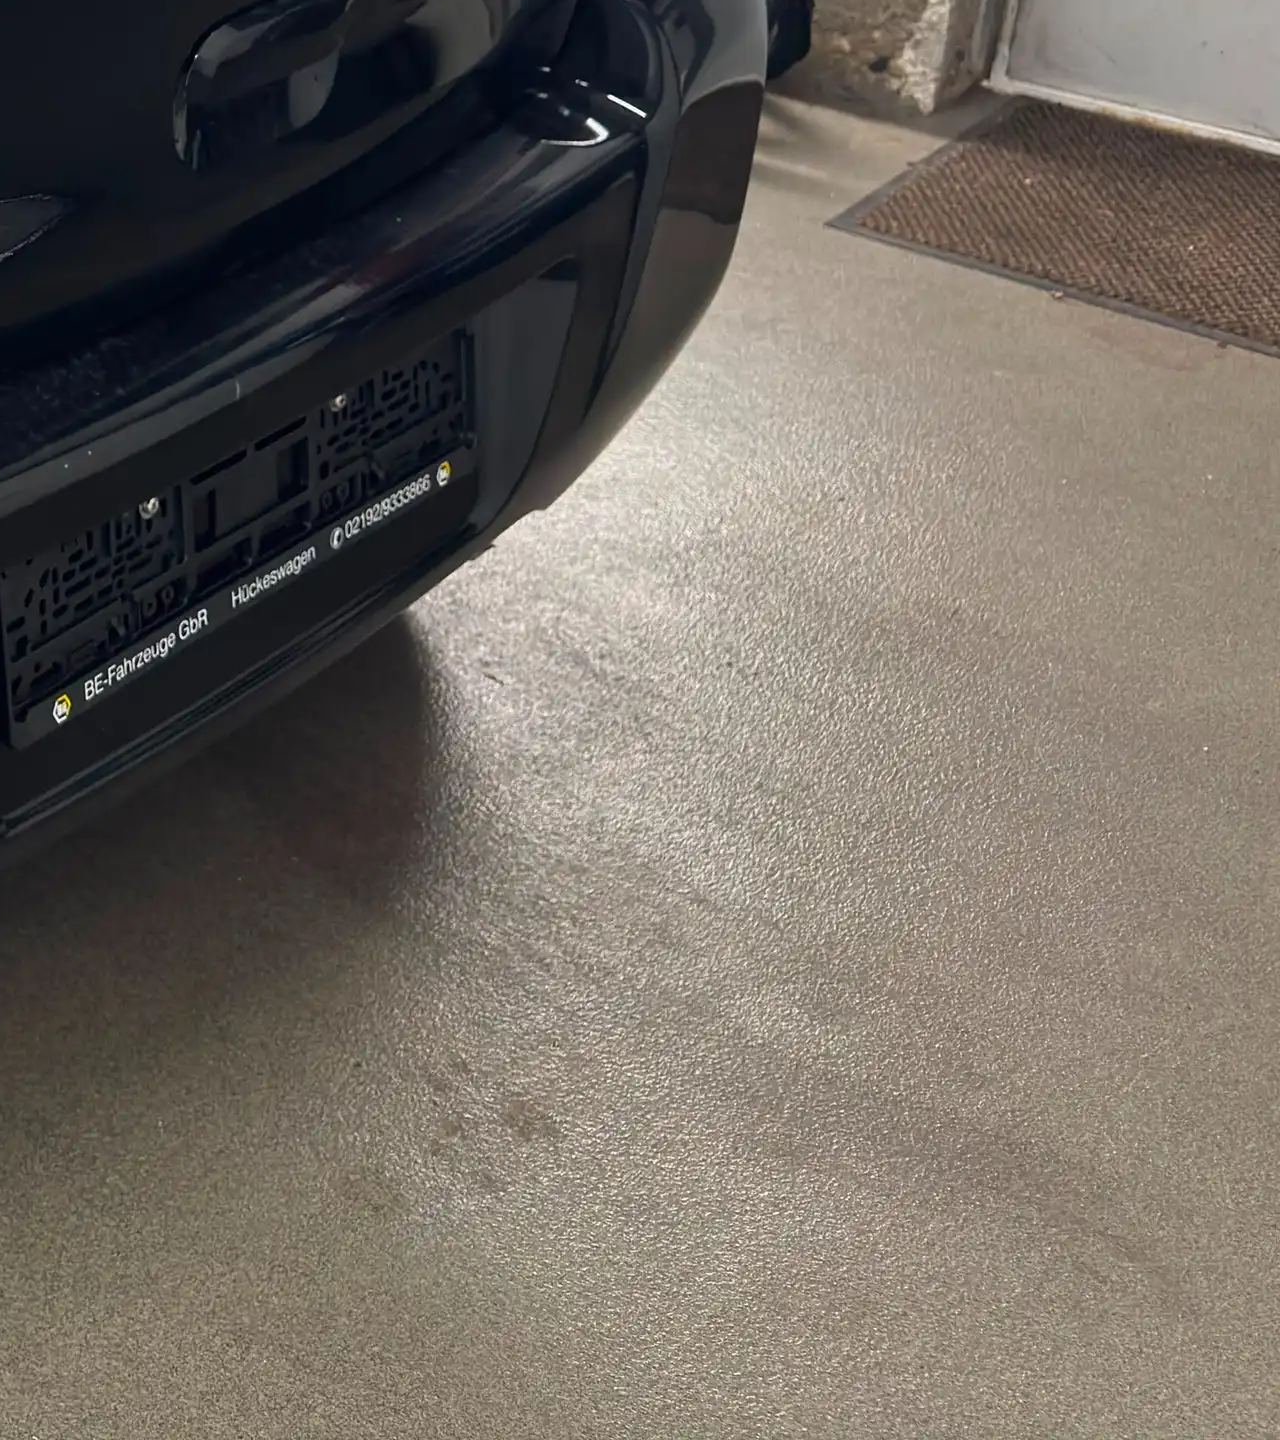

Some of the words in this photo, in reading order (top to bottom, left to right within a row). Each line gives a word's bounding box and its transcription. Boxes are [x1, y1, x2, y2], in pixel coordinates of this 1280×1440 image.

[83, 631, 177, 701] BE-Fahrzeuge
[178, 607, 209, 641] GbR
[230, 545, 317, 609] Hückeswagen
[344, 473, 432, 539] 02192/9333866
